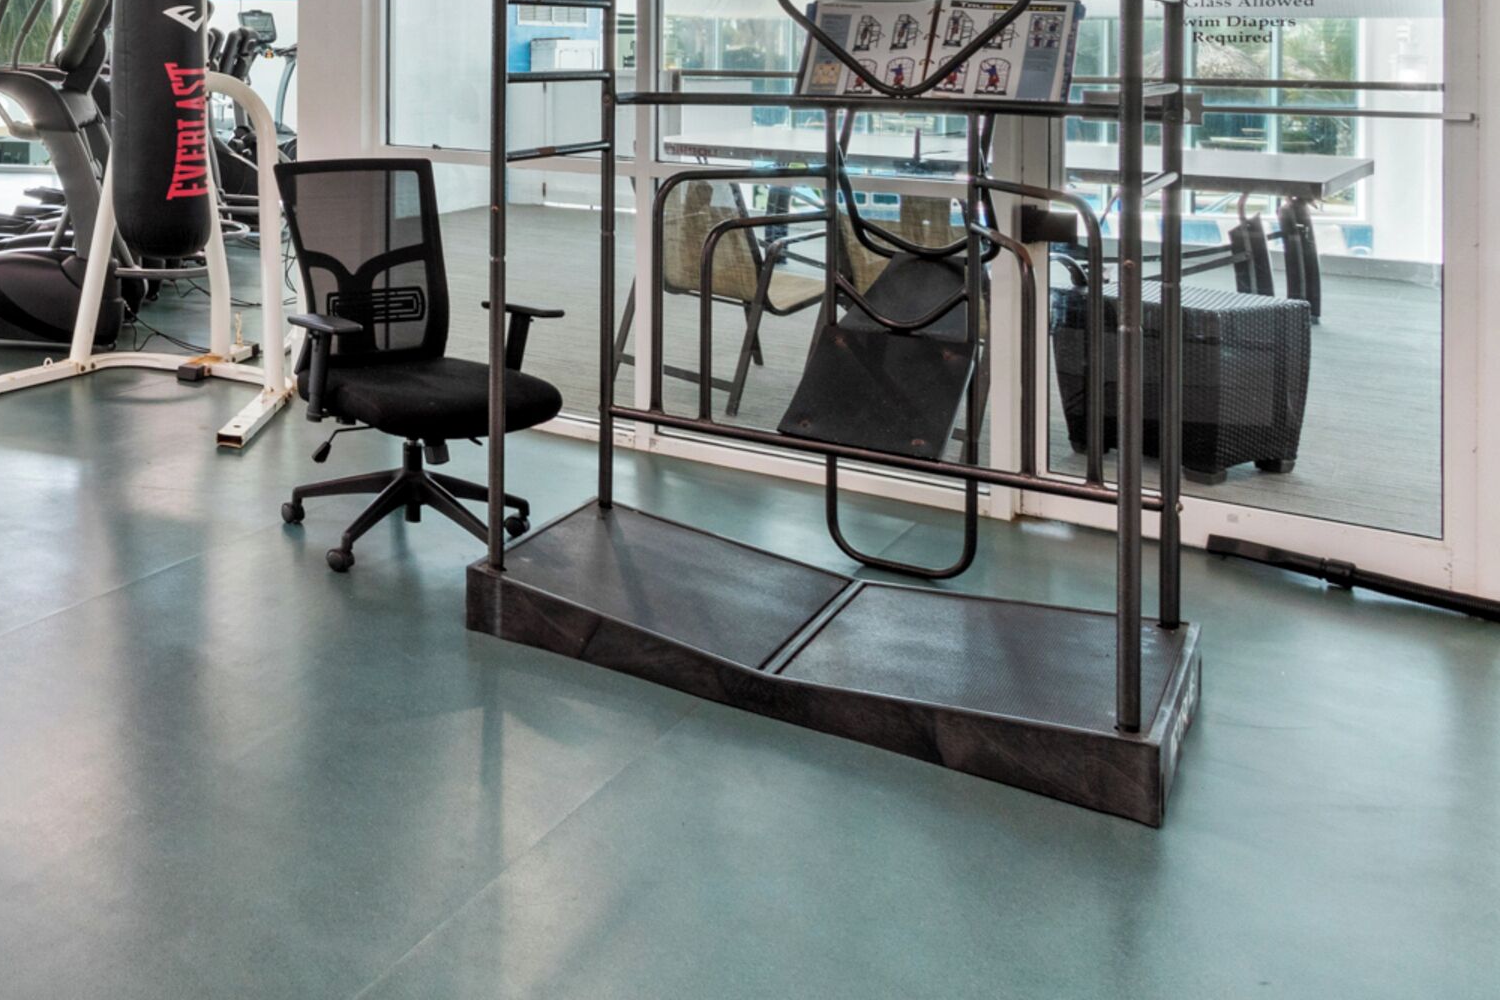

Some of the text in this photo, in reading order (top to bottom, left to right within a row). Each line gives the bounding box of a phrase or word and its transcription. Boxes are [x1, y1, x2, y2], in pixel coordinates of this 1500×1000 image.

[1184, 16, 1296, 30] wim Diapers
[1192, 32, 1273, 46] Required
[164, 62, 208, 200] EVERLAST
